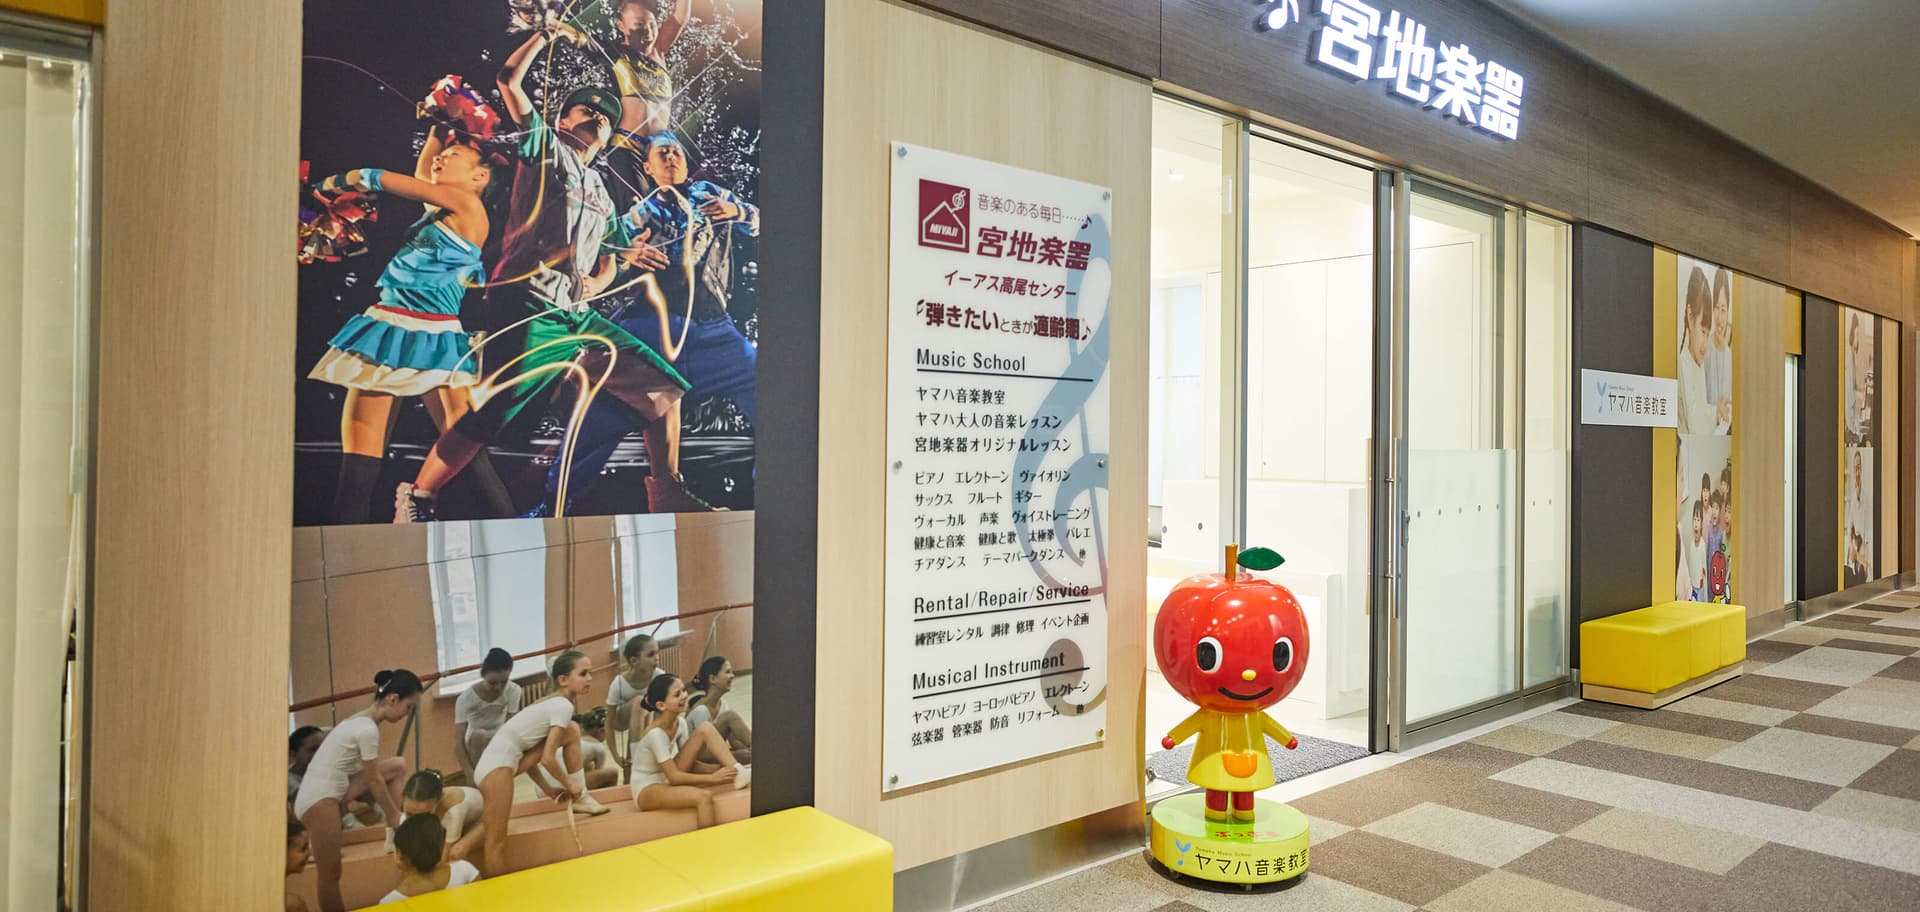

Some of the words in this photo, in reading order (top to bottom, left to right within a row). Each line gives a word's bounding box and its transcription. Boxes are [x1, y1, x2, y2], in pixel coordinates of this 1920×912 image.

[1318, 0, 1524, 140] 宮地楽器
[929, 223, 958, 237] MIYAJI
[976, 226, 1092, 270] 宮地楽器
[944, 270, 1076, 299] イーアス高尾センター
[916, 348, 966, 368] Music
[973, 352, 1026, 372] School
[916, 386, 1006, 405] ヤマハ音楽教室
[1608, 391, 1667, 415] ヤマハ音楽教室
[916, 411, 1063, 429] ヤマハ大人の音楽レッスン
[915, 436, 1072, 453] 宮地楽器オリジナルレッスン
[915, 471, 944, 485] ピアノ
[954, 471, 1009, 484] エレクトーン
[1019, 469, 1071, 483] ヴァイオリン
[915, 492, 953, 507] サックス
[968, 491, 1003, 505] フルート
[1015, 490, 1042, 503] ギター
[914, 513, 966, 529] ヴォーカル
[979, 511, 1000, 526] 声楽
[1011, 507, 1091, 524] ヴォイストレーニング
[914, 534, 966, 551] 健康と音楽
[1028, 528, 1055, 544] 太極拳
[1065, 527, 1091, 539] バレエ
[914, 555, 966, 572] チアダンス
[983, 548, 1065, 567] テーマパークダンス
[913, 582, 1090, 614] Rental/Repair/Service
[915, 625, 984, 647] 練習室レンタル
[1016, 619, 1035, 635] 修理
[1040, 612, 1090, 631] イベント企画
[912, 664, 978, 690] Musical
[984, 652, 1066, 679] Instrument
[912, 703, 967, 724] ヤマハピアノ
[973, 690, 1036, 713] ヨーロッパピアノ
[1044, 680, 1090, 698] エレクトーン
[911, 727, 944, 747] 弦楽器
[952, 719, 983, 739] 管楽器
[990, 714, 1009, 731] 防音
[1017, 705, 1060, 725] リフォーム
